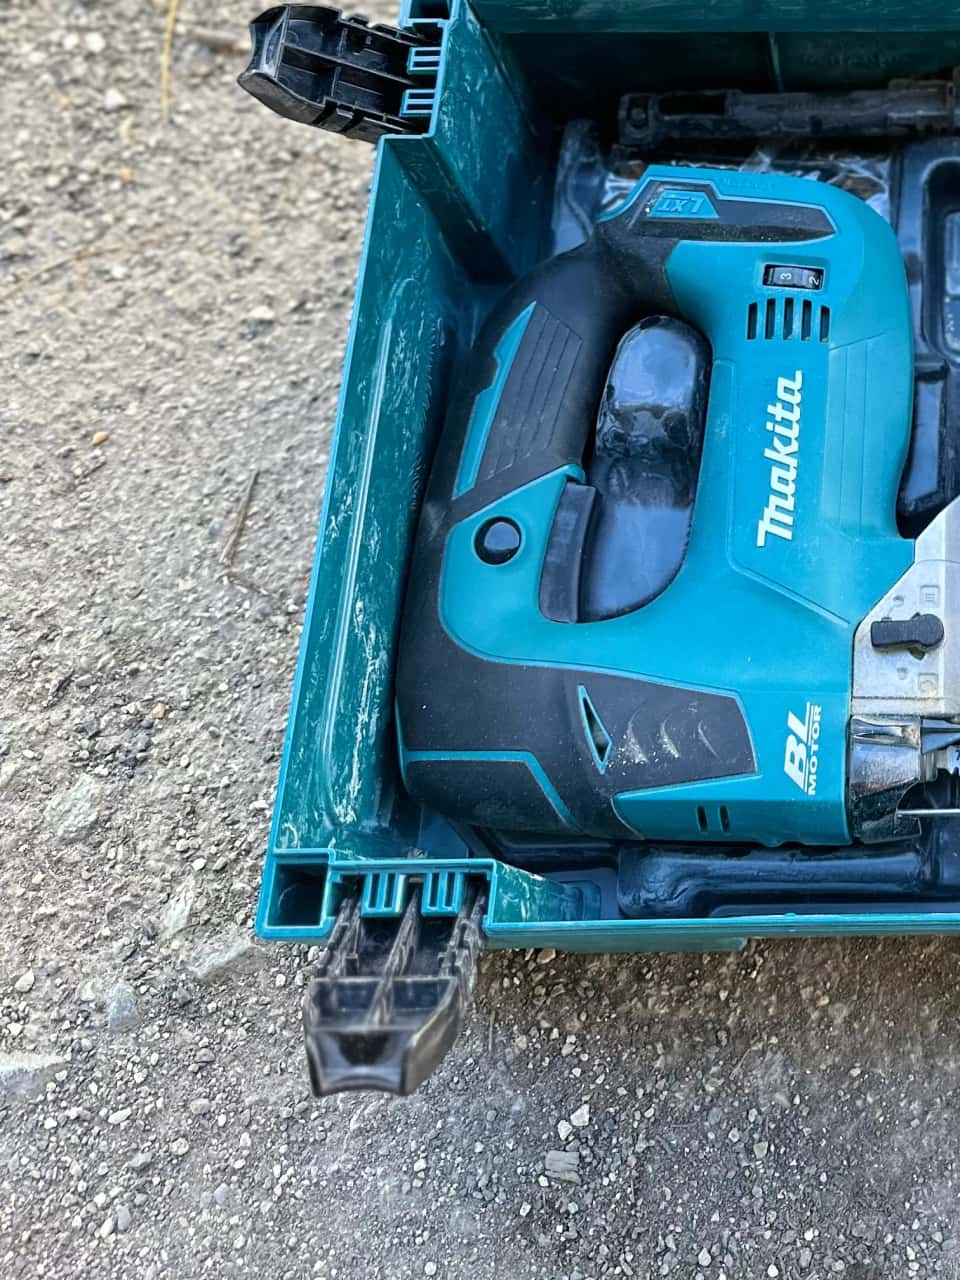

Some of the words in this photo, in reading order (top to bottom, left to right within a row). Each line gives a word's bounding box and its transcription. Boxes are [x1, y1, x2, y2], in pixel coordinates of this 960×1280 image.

[657, 195, 703, 214] LXT
[780, 272, 792, 280] 3
[809, 275, 820, 286] 2
[756, 370, 802, 547] Makita
[784, 701, 811, 791] BL
[808, 705, 822, 795] MOTOR
